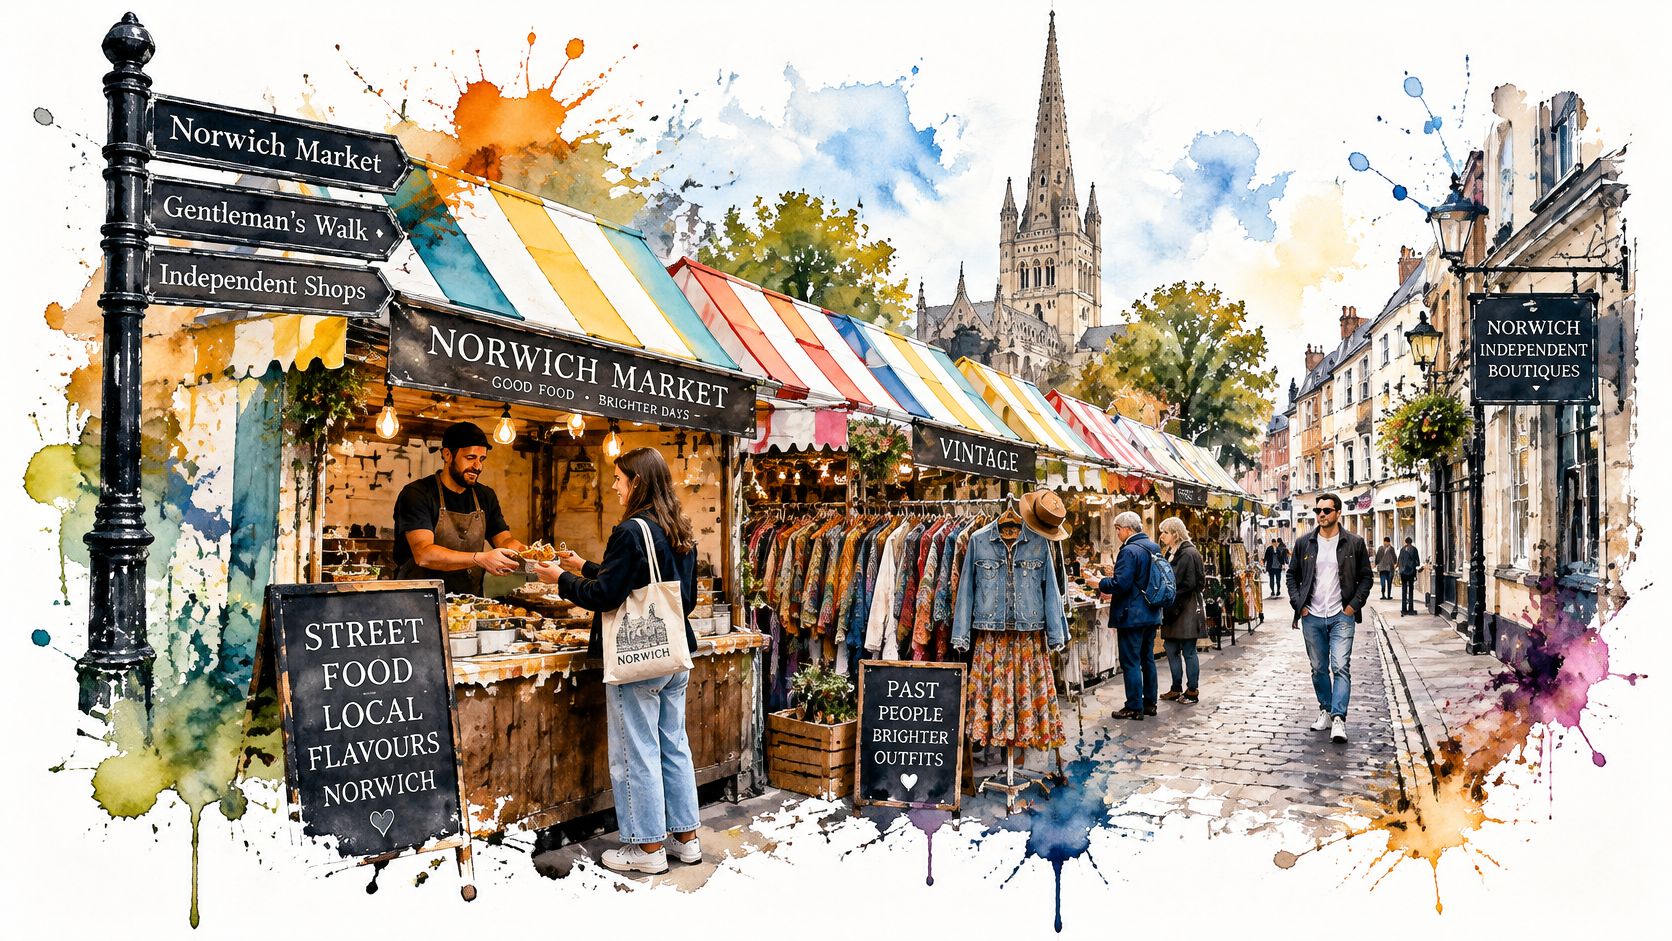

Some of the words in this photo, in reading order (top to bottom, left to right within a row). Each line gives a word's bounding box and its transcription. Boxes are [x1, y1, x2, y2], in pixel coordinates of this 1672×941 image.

[170, 115, 286, 157] Norwich
[296, 138, 382, 174] Market
[163, 195, 306, 233] Gentleman's
[314, 214, 369, 242] Walk
[159, 263, 297, 296] Independent
[304, 275, 366, 304] Shops
[1487, 320, 1581, 336] NORWICH
[1480, 343, 1588, 357] INDEPENDENT
[427, 325, 598, 385] NORWICH
[611, 362, 729, 409] MARKET
[1488, 364, 1580, 381] BOUTIQUES
[491, 376, 533, 394] GOOD
[539, 384, 575, 401] FOOD
[598, 394, 658, 416] BRIGHTER
[661, 406, 690, 420] DAYS
[940, 437, 1019, 472] VINTAGE
[305, 618, 424, 651] STREET
[617, 647, 671, 666] NORWICH
[322, 657, 413, 690] FOOD
[886, 680, 940, 699] PAST
[322, 697, 423, 732] LOCAL
[878, 705, 944, 723] PEOPLE
[308, 731, 440, 771] FLAVOURS
[872, 728, 950, 745] BRIGHTER
[874, 750, 944, 767] OUTFITS
[323, 769, 437, 808] NORWICH
